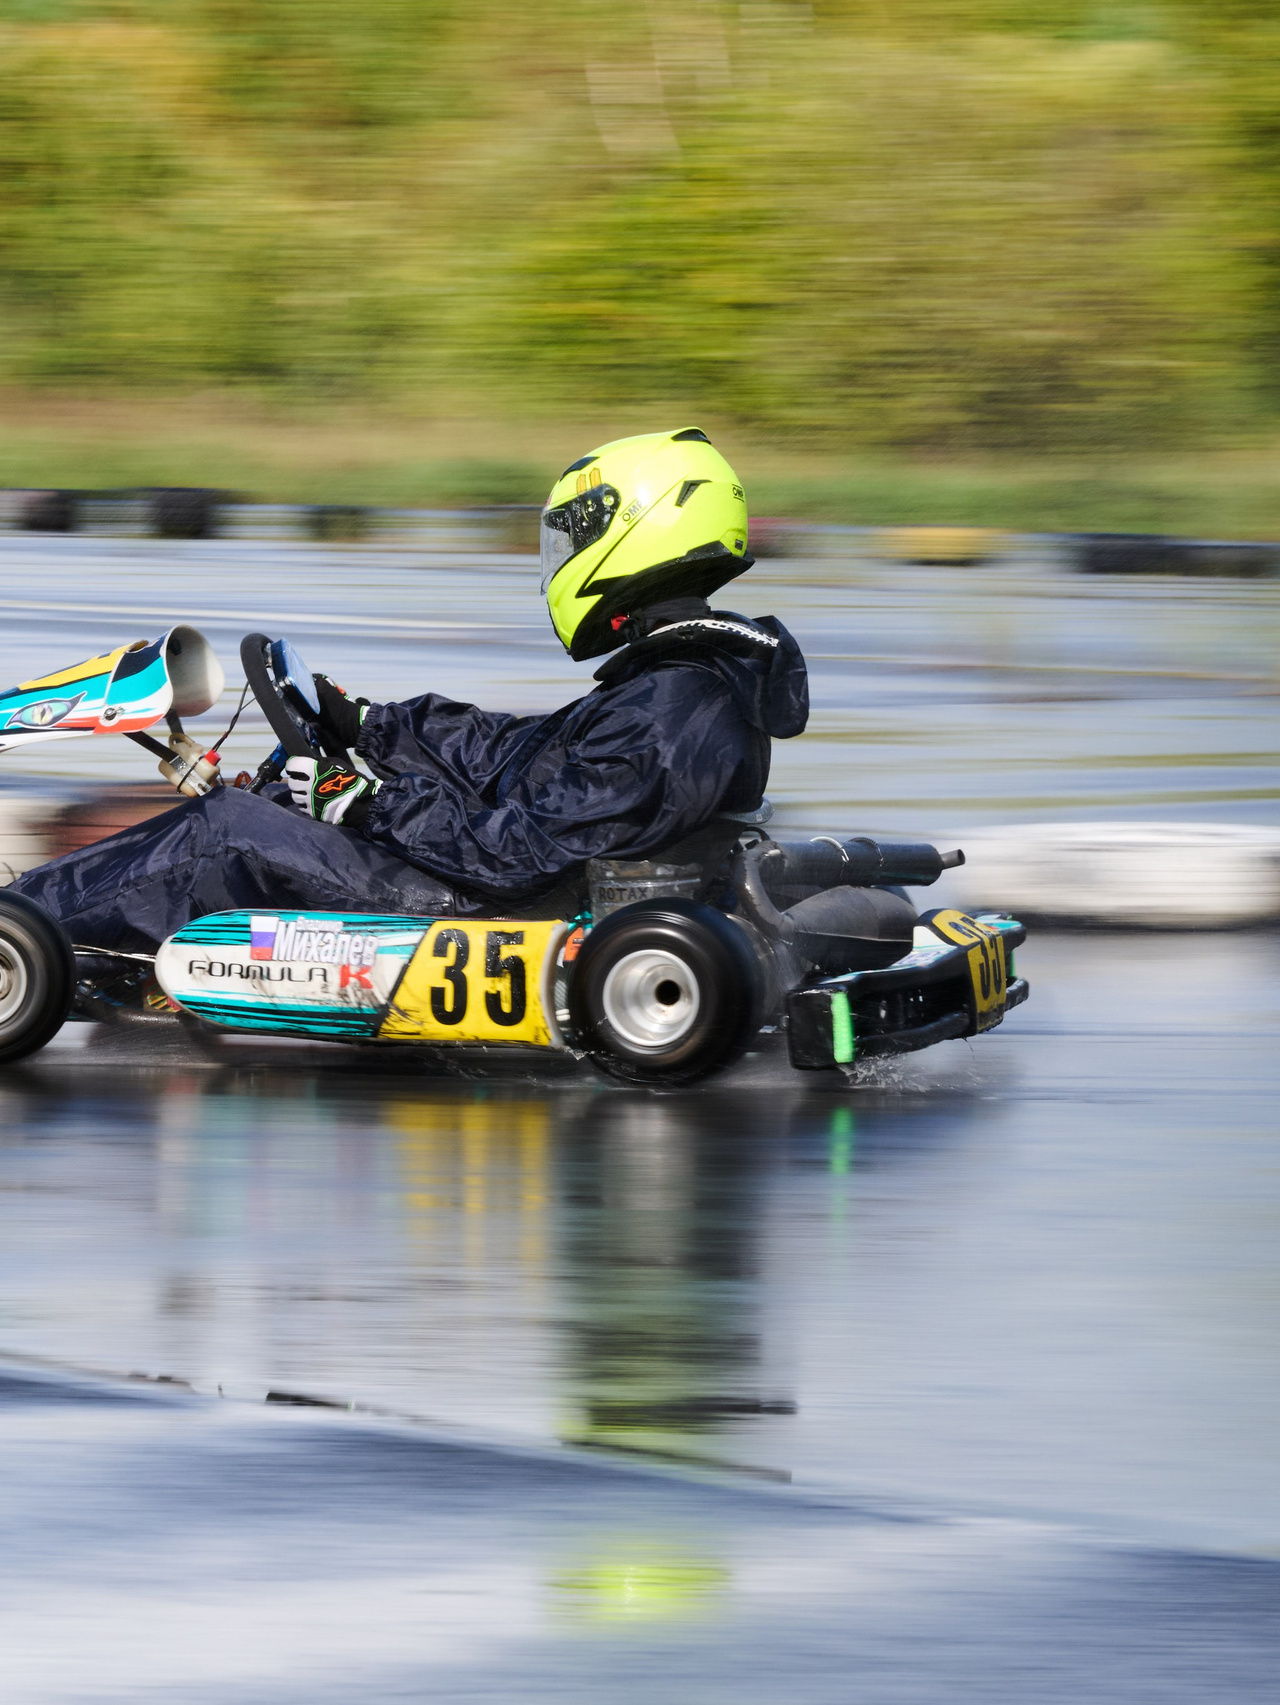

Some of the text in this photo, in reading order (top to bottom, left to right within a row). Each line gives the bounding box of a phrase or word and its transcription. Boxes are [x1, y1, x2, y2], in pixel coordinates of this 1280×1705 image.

[600, 887, 647, 901] ROTAX
[272, 920, 378, 966] Михалев
[188, 960, 374, 989] FORMULA K
[430, 928, 527, 1027] 35
